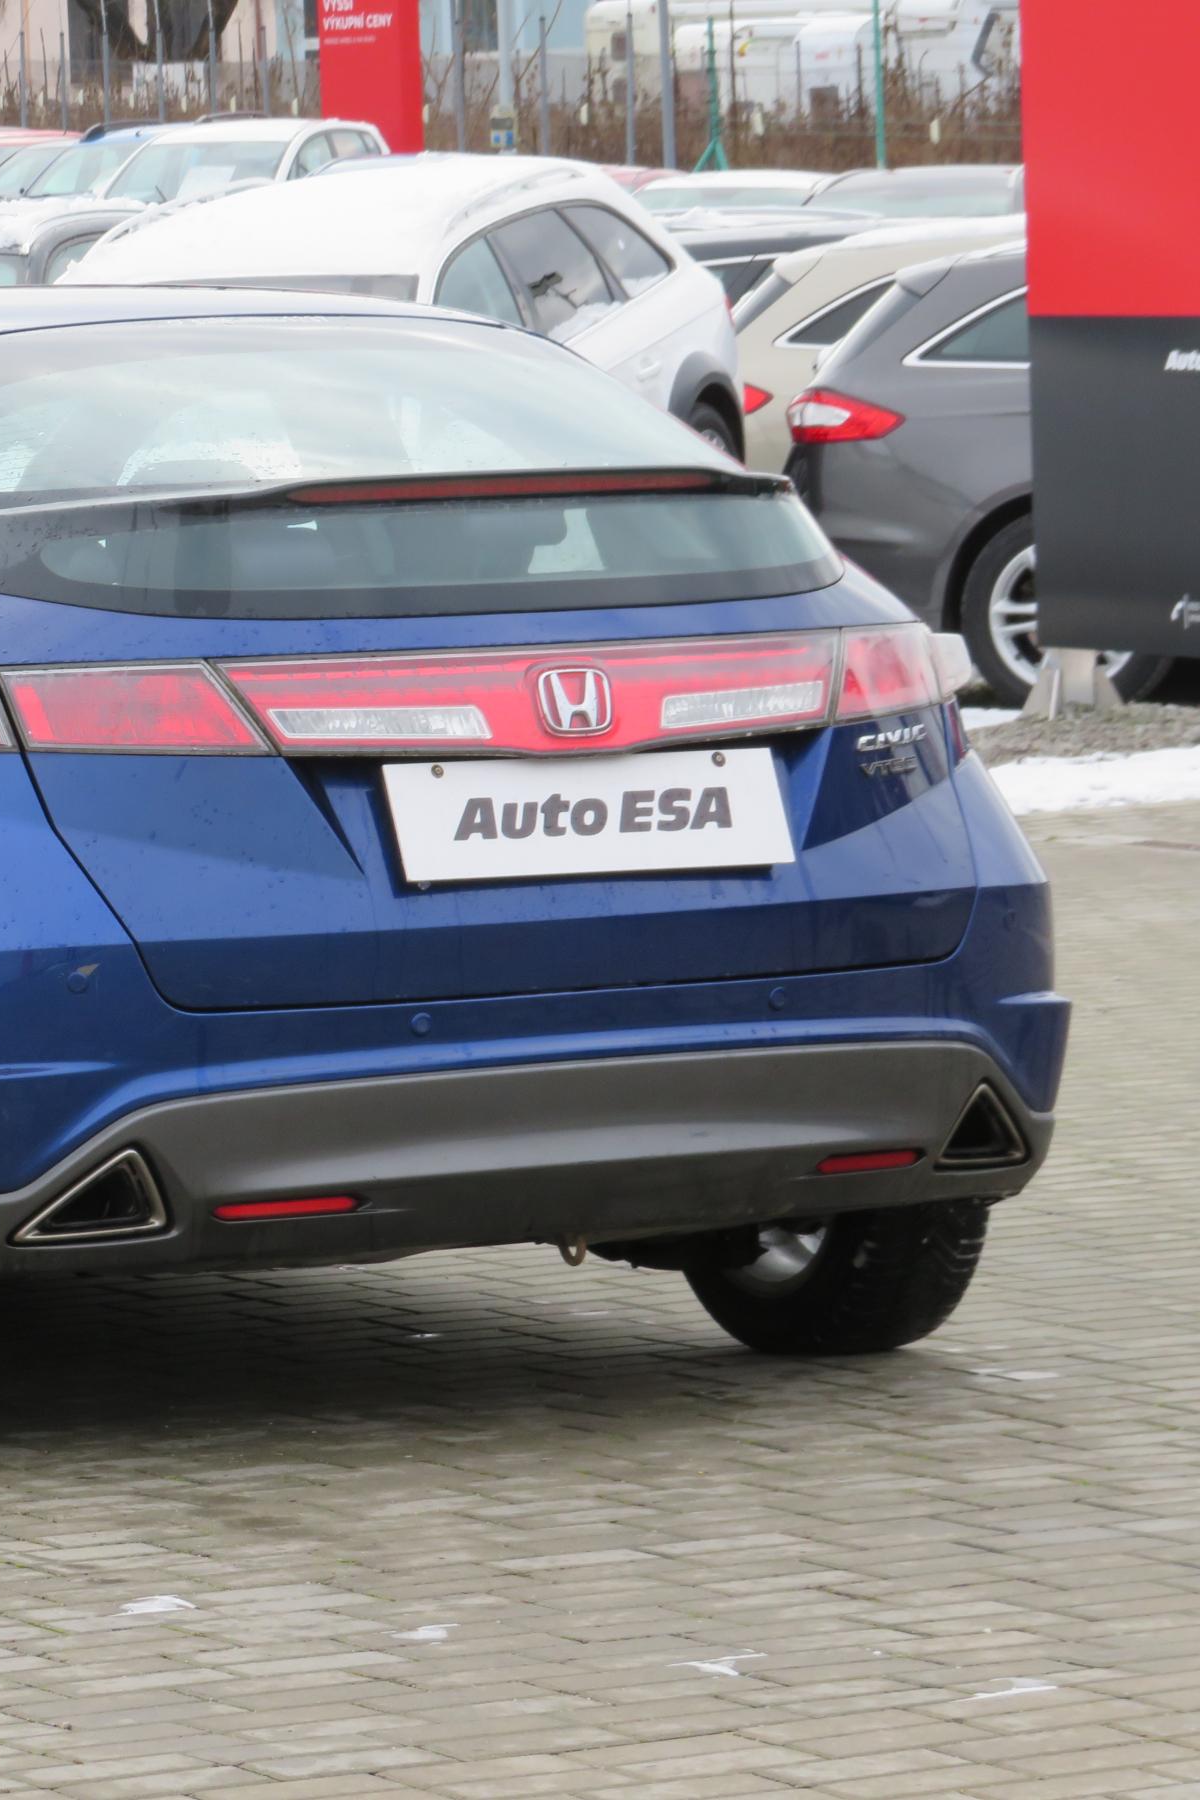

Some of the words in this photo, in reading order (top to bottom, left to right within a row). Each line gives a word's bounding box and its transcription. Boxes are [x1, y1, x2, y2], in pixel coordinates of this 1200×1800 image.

[366, 12, 393, 29] CENY
[857, 724, 927, 751] CIVIC
[453, 793, 608, 841] Auto
[619, 786, 733, 833] ESA
